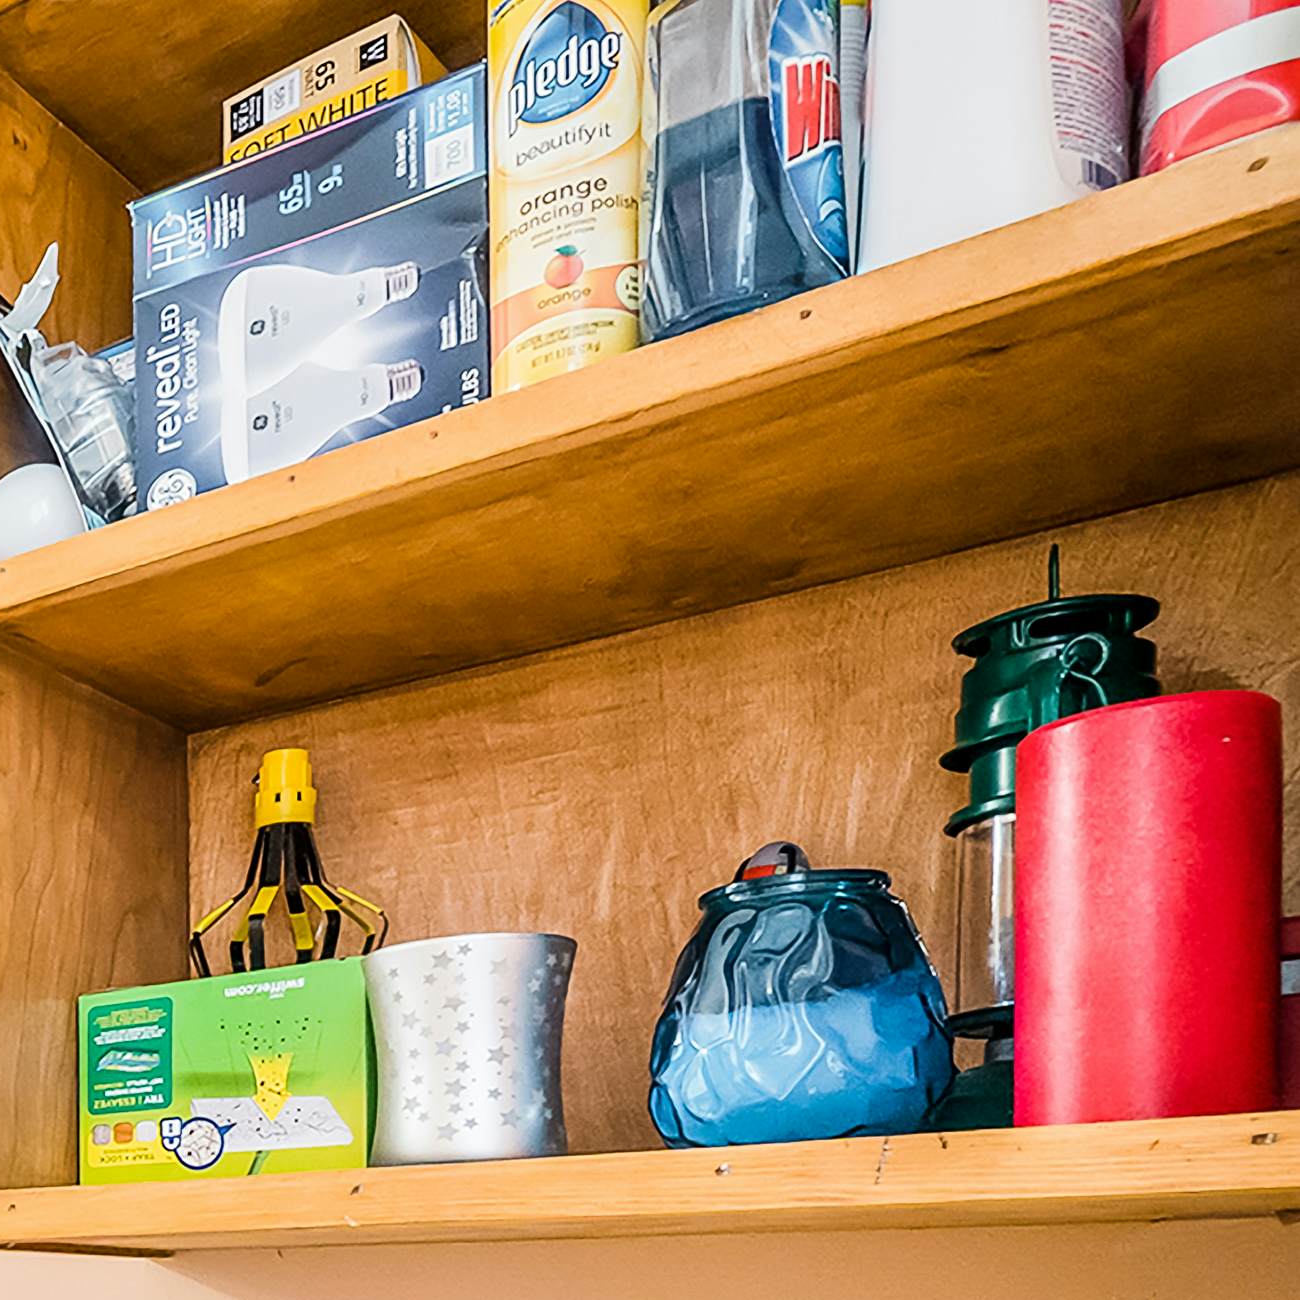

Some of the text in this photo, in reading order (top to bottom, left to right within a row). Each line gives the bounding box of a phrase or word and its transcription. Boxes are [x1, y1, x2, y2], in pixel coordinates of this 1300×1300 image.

[304, 65, 314, 98] WATT
[315, 59, 335, 91] 65
[508, 31, 622, 138] pledge
[298, 78, 388, 132] WHITE
[446, 139, 461, 169] 700
[519, 176, 608, 217] orange
[185, 206, 206, 260] LIGHT
[495, 199, 584, 254] enhancing
[591, 194, 639, 213] polish
[536, 287, 592, 310] orange
[147, 302, 183, 454] reveal LED
[224, 977, 305, 999] swiffer.com
[143, 1093, 165, 1105] TRY
